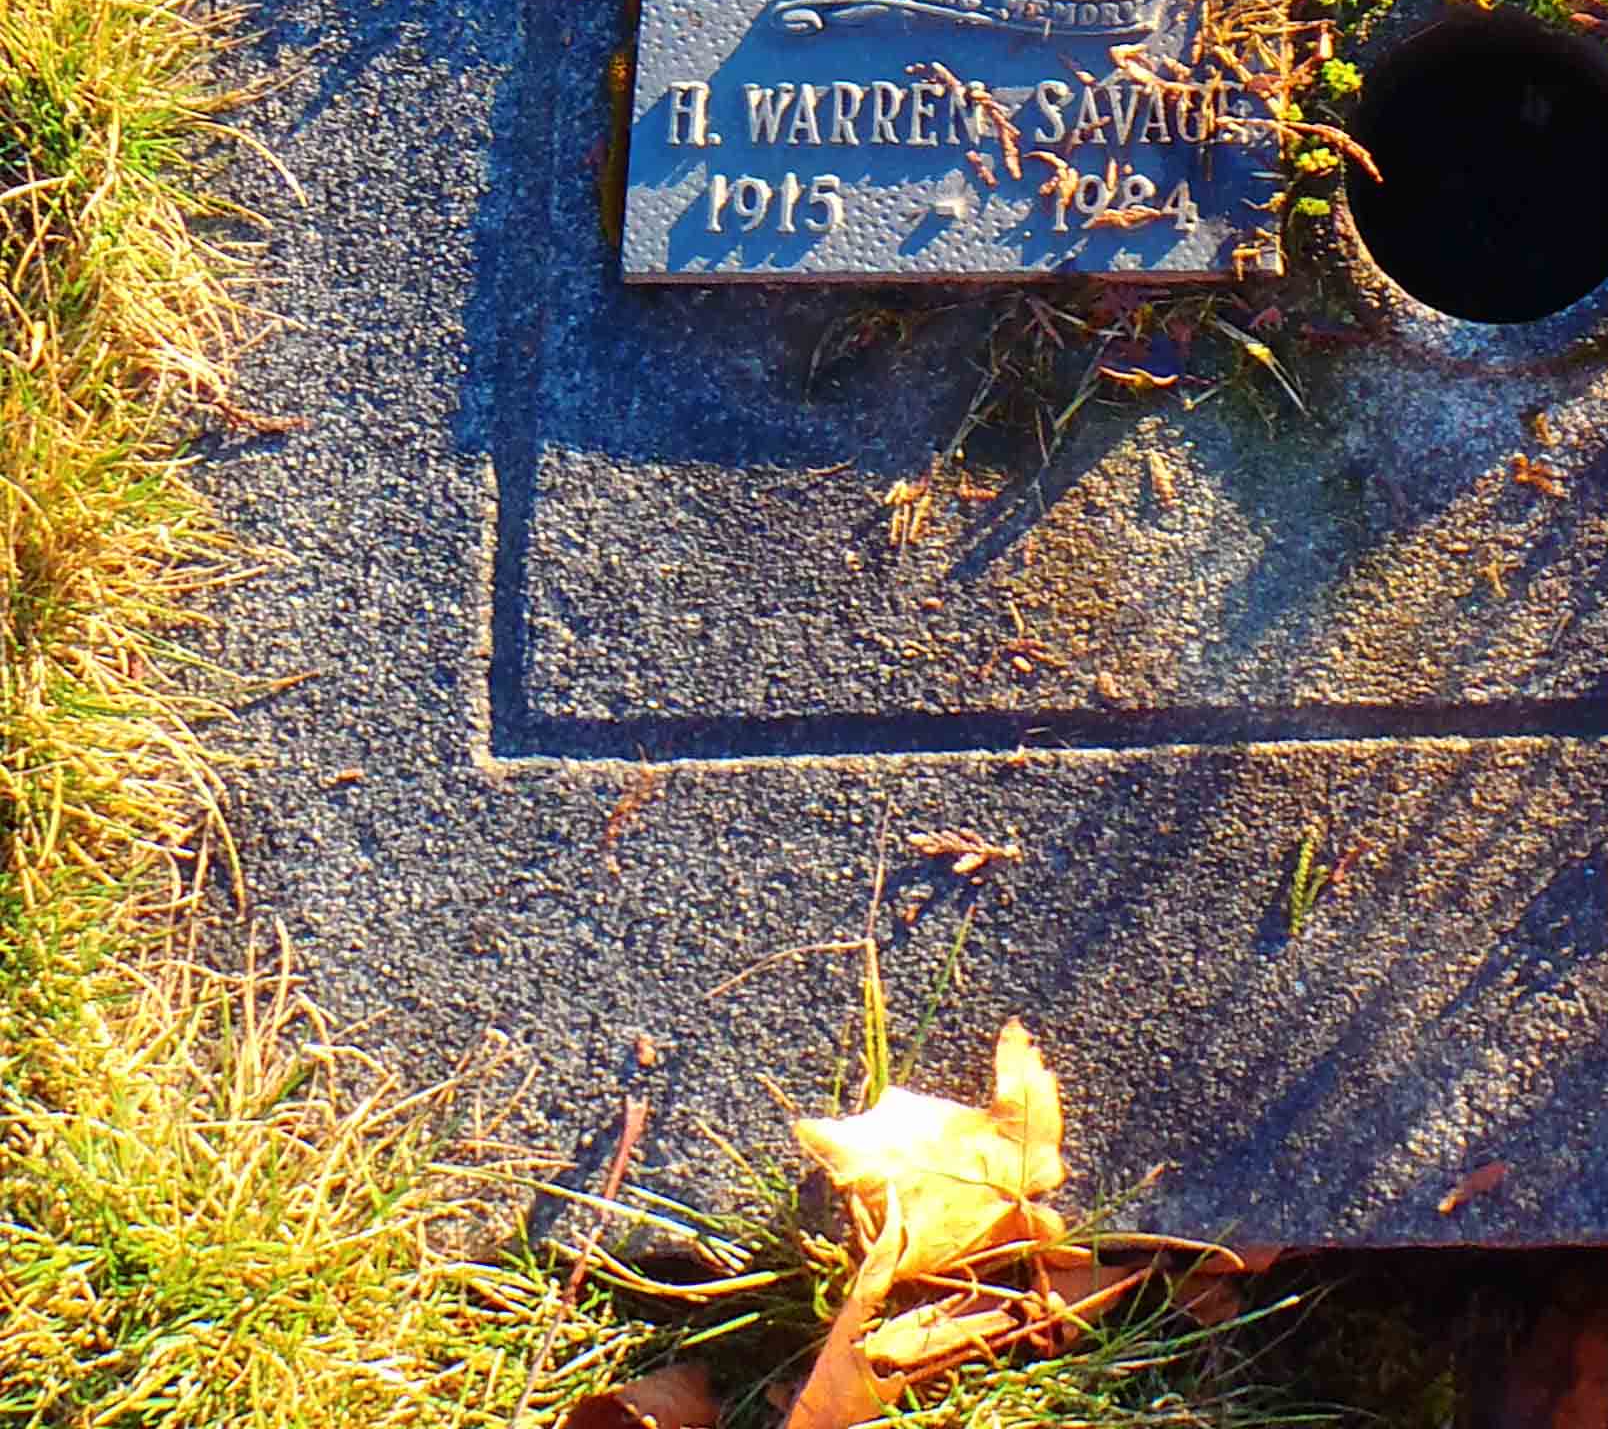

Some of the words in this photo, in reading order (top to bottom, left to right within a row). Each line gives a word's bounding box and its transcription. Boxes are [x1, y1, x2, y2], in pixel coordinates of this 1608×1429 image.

[666, 82, 720, 146] H.
[742, 82, 998, 145] WARREN
[706, 174, 843, 233] 1915
[1052, 174, 1198, 232] 1984
